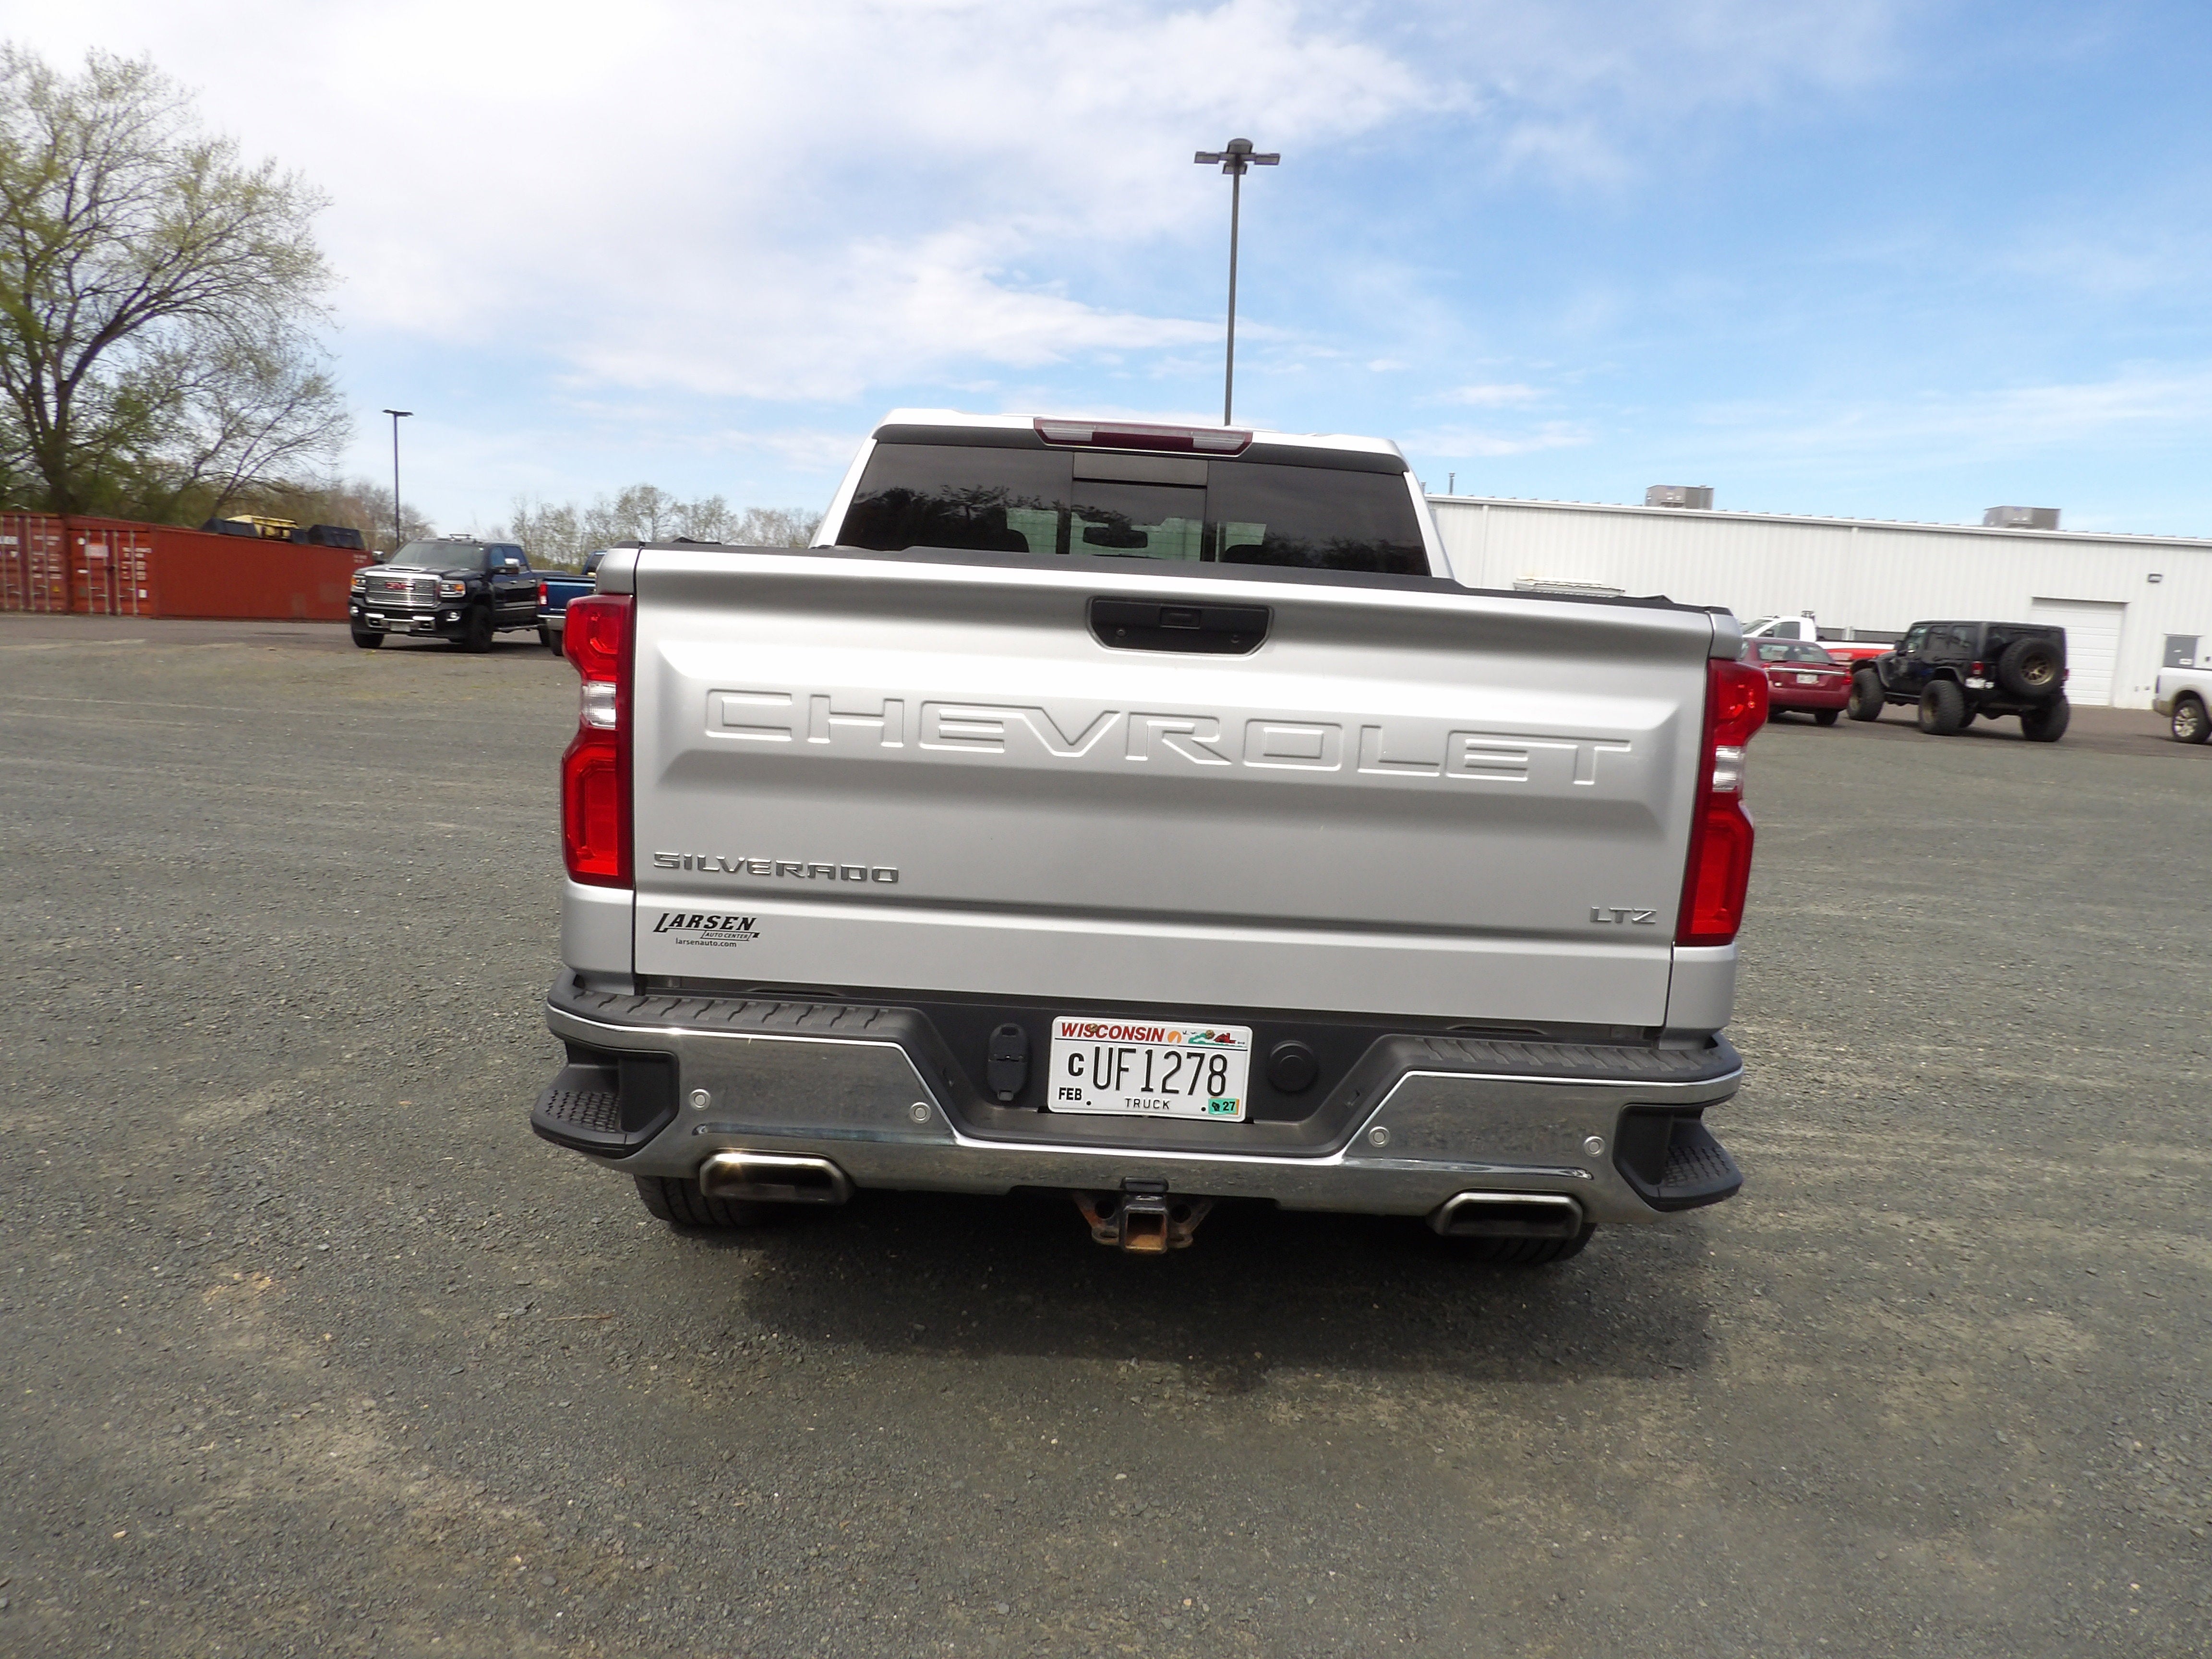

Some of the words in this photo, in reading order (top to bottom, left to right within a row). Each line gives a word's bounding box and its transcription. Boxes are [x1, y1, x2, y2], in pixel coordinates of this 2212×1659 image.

[704, 688, 1631, 785] CHEVROLET
[654, 851, 899, 883] SILVERADO
[653, 913, 757, 933] LARSEN
[1590, 906, 1657, 924] LTZ
[675, 938, 737, 947] larsenauto.com
[1061, 1022, 1166, 1042] WISCONSIN
[1058, 1087, 1082, 1101] FEB
[1125, 1098, 1170, 1110] TRUCK
[1222, 1101, 1236, 1111] 27
